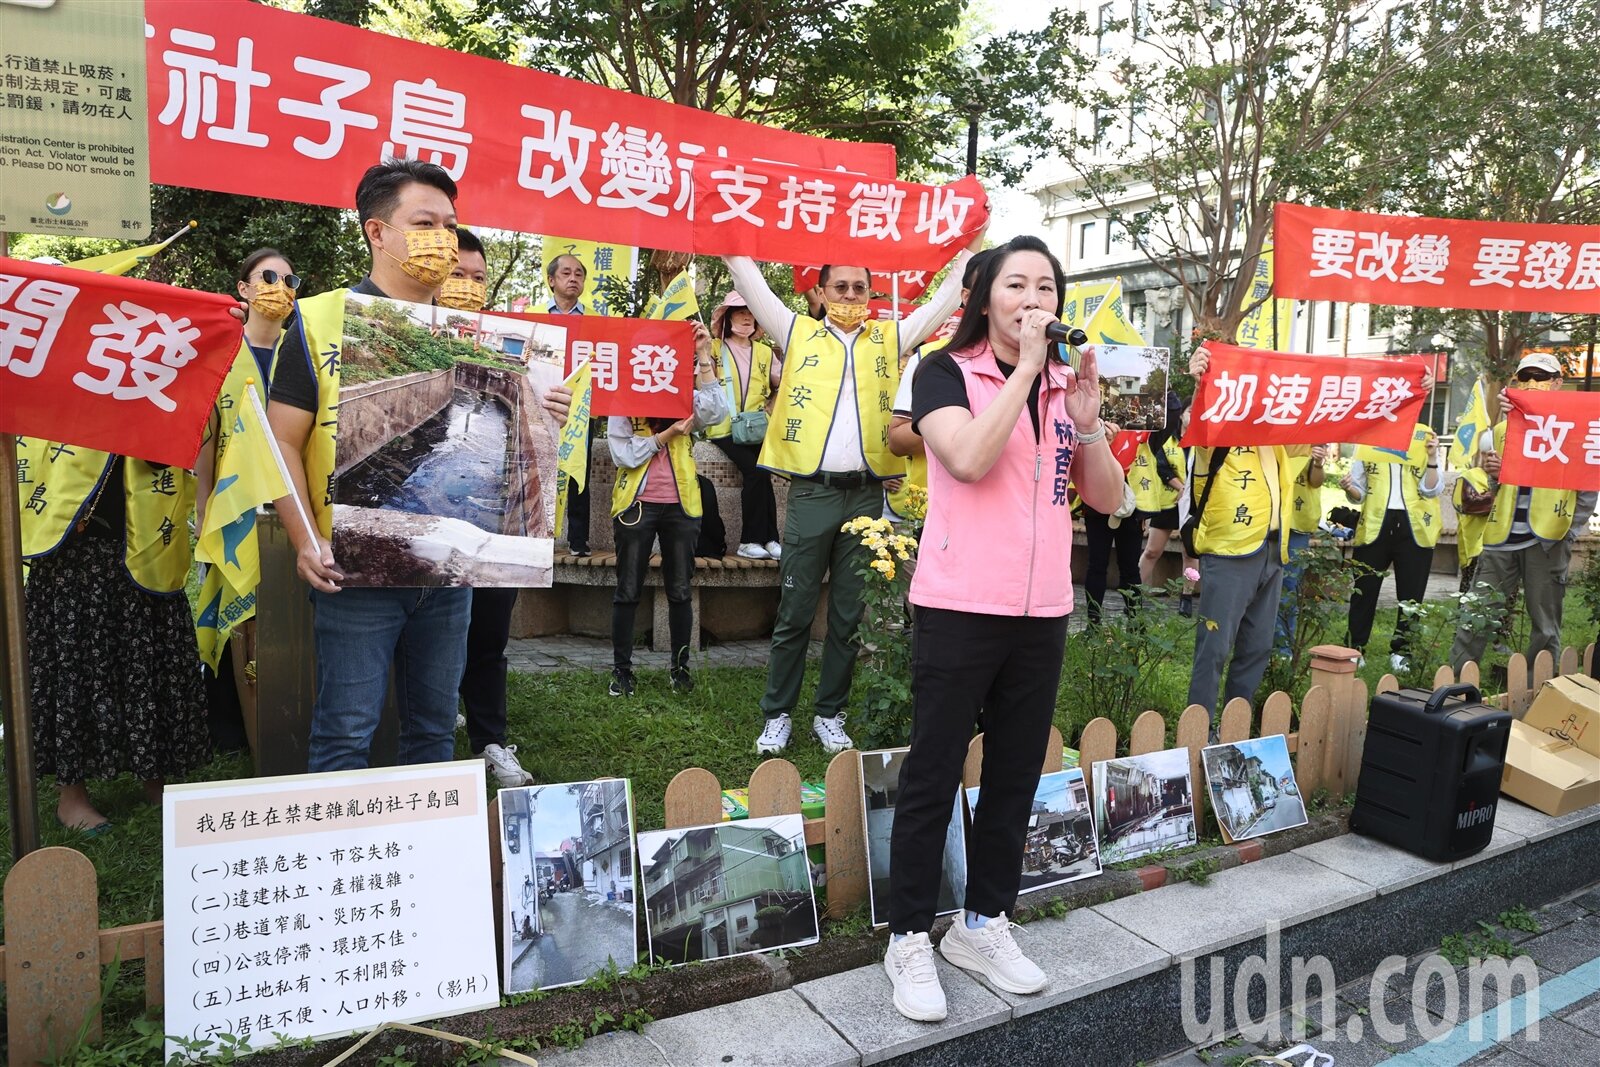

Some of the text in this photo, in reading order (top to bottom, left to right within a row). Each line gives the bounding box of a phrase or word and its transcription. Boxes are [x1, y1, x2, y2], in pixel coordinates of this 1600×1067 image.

[0, 53, 126, 82] 行道禁止吸菸，
[0, 73, 132, 102] 制法規定，可處
[146, 18, 473, 182] 社子島
[0, 134, 134, 154] istration Center is prohibited
[0, 145, 135, 166] tion Act. Violator would be
[12, 158, 45, 170] Please
[47, 161, 63, 171] DO
[66, 163, 87, 173] NOT
[90, 166, 120, 176] smoke
[123, 169, 135, 177] on
[711, 166, 975, 246] 支持徵收
[1310, 227, 1451, 286] 要改變
[0, 273, 201, 413] 開發
[571, 340, 680, 394] 開發
[781, 327, 829, 444] 戶戶安置
[1200, 371, 1414, 426] 加速開發
[1052, 418, 1074, 506] 林杏兒
[151, 469, 178, 546] 進會
[196, 789, 460, 834] 我居住在禁建雜亂的社子島國
[1456, 803, 1494, 830] MIPRO
[191, 842, 414, 883] (一)建築危老、市容失格。
[191, 871, 415, 914] (二)違建林立、產權複雜。
[192, 899, 416, 946] (三)巷道窄亂、災防不易。
[193, 930, 417, 978] (四)公設停滯、環境不佳。
[193, 960, 419, 1011] (五)土地私有、不利開發。
